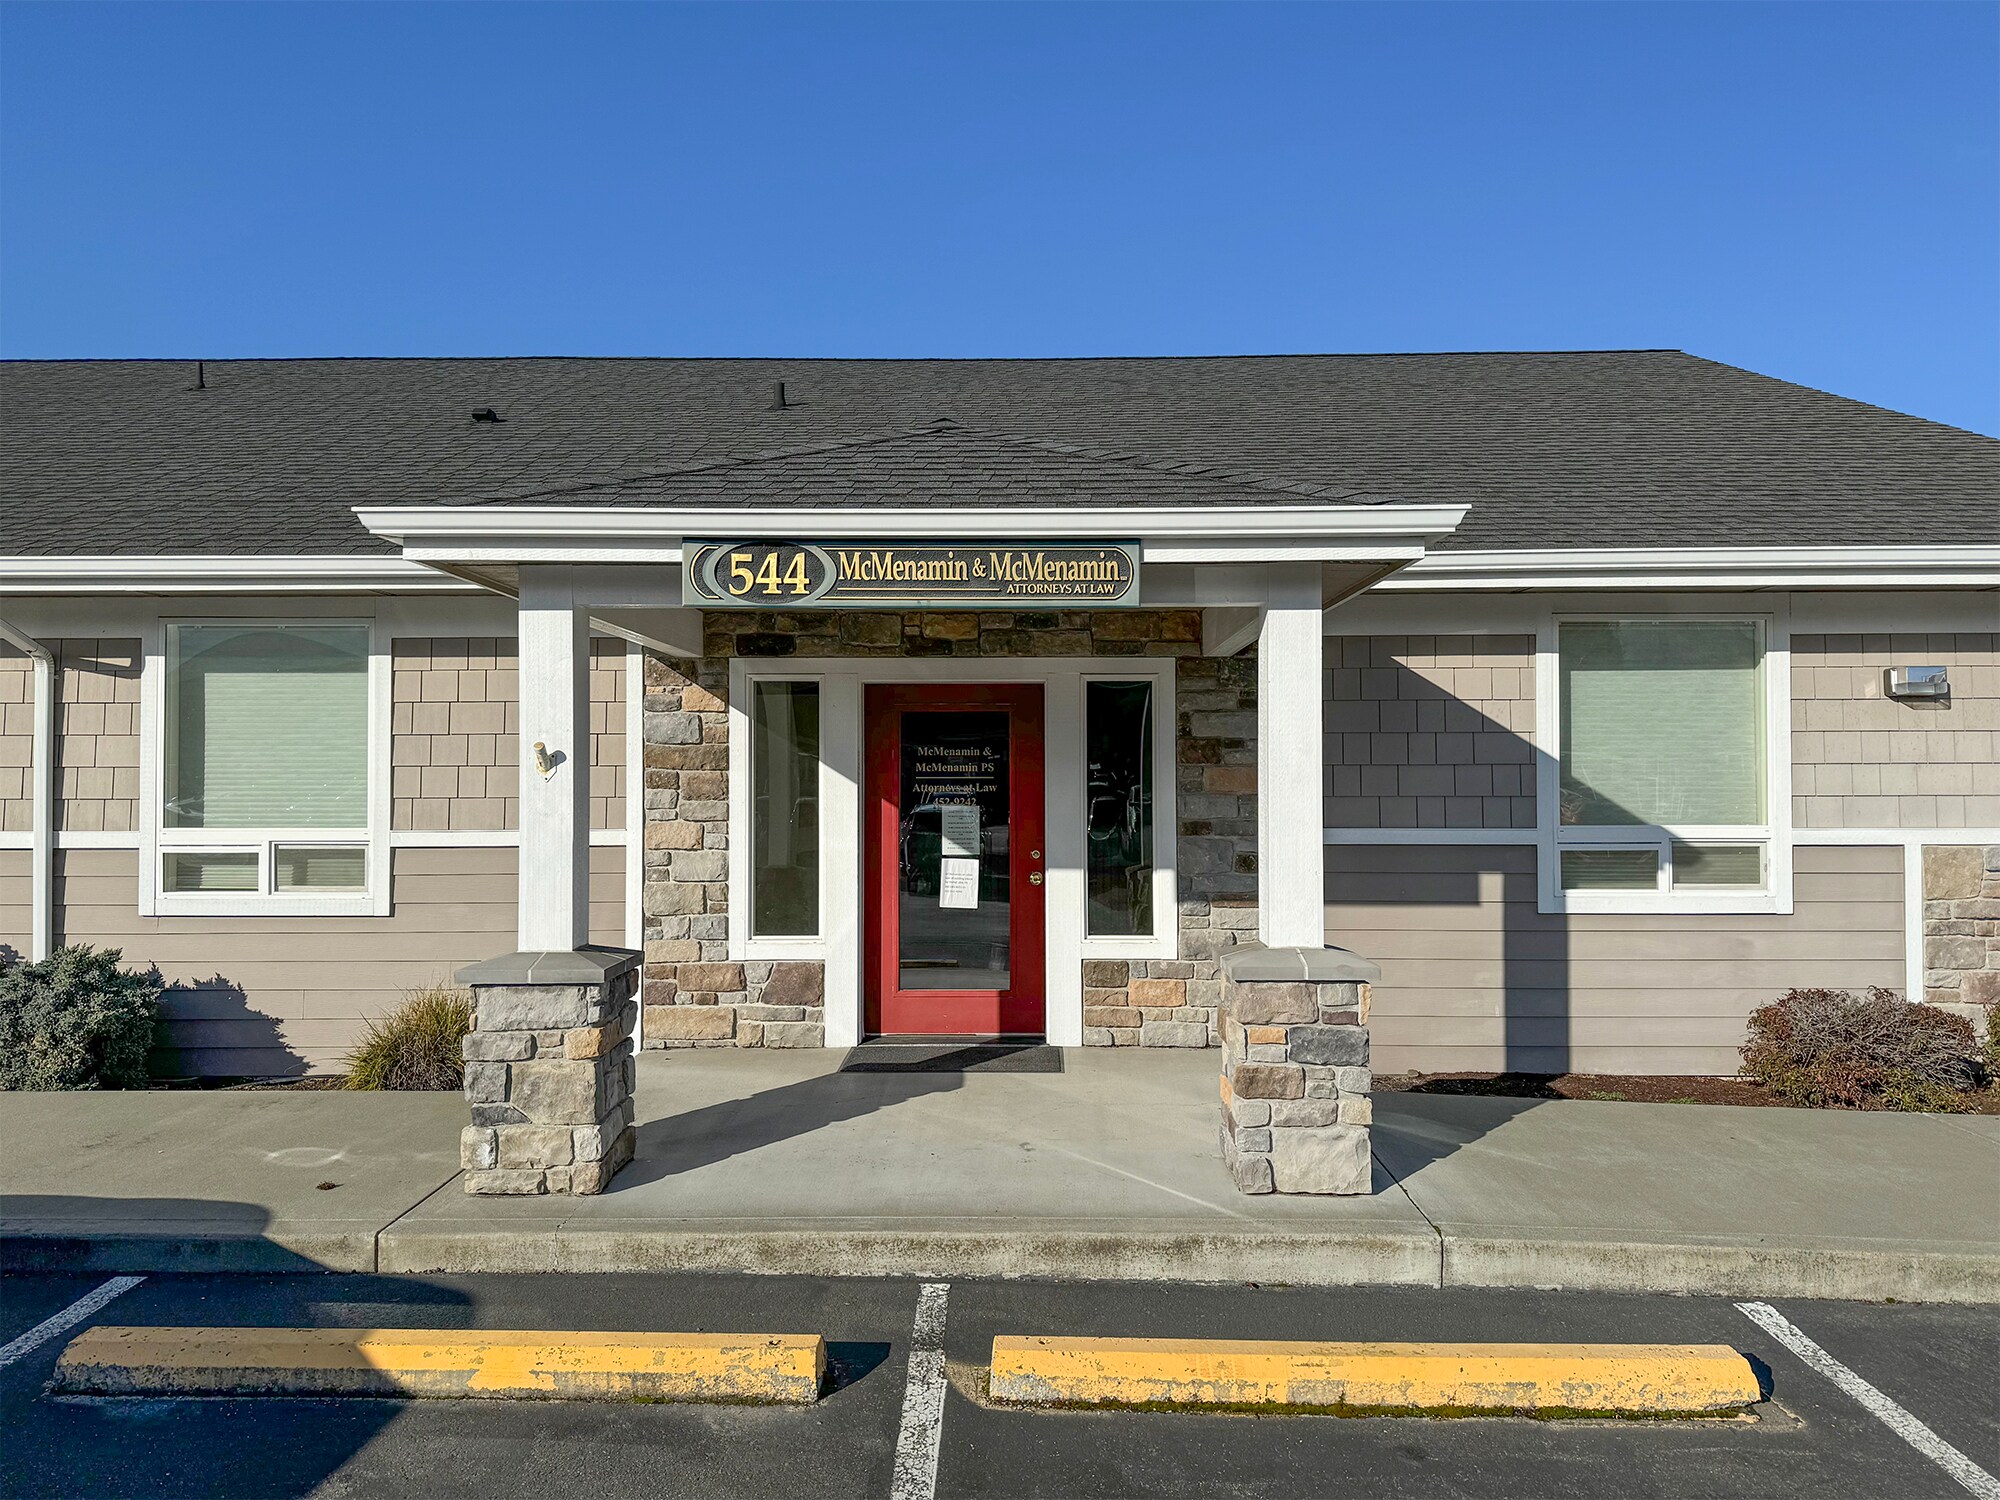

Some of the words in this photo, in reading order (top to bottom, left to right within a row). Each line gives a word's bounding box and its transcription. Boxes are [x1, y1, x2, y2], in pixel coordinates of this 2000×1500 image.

[838, 551, 968, 581] McMenamin
[972, 557, 987, 578] &
[989, 551, 1120, 581] McMenamin
[728, 552, 810, 595] 544
[1006, 583, 1072, 594] ATTORNEYS
[1074, 583, 1088, 594] AT
[1090, 583, 1115, 594] LAW
[917, 746, 980, 756] McMenamin
[982, 746, 992, 756] &
[915, 762, 978, 772] McMenamin
[981, 762, 995, 772] PS
[912, 783, 961, 794] Attorneys
[963, 783, 974, 793] at
[976, 783, 998, 793] Law
